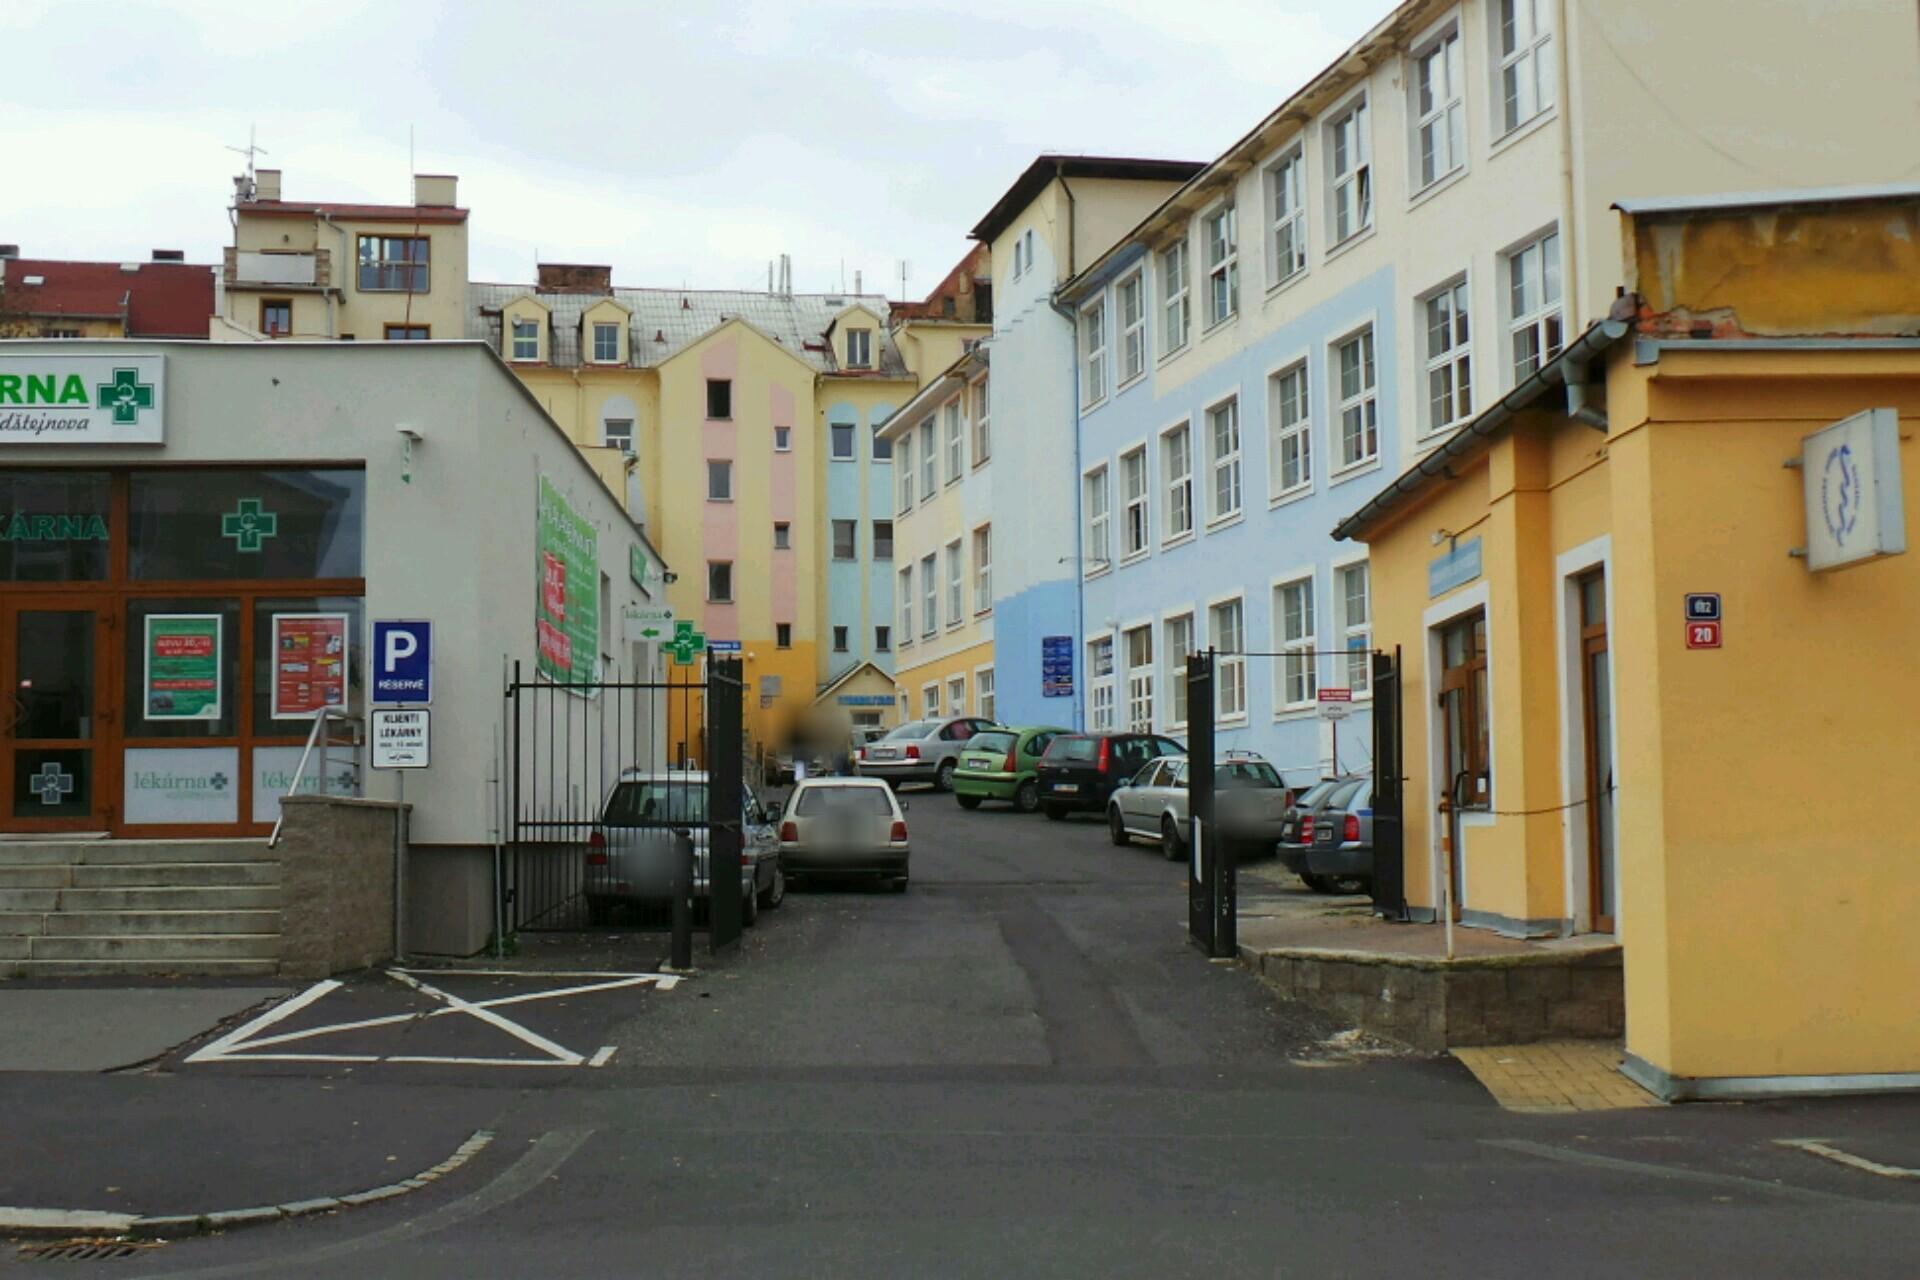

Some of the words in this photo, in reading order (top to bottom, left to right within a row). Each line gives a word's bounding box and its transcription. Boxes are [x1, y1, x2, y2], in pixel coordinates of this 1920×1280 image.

[0, 412, 90, 436] dštejnova
[0, 508, 109, 540] ÁRNA
[1694, 627, 1712, 643] 20
[384, 630, 418, 673] P
[134, 771, 208, 789] lékárna
